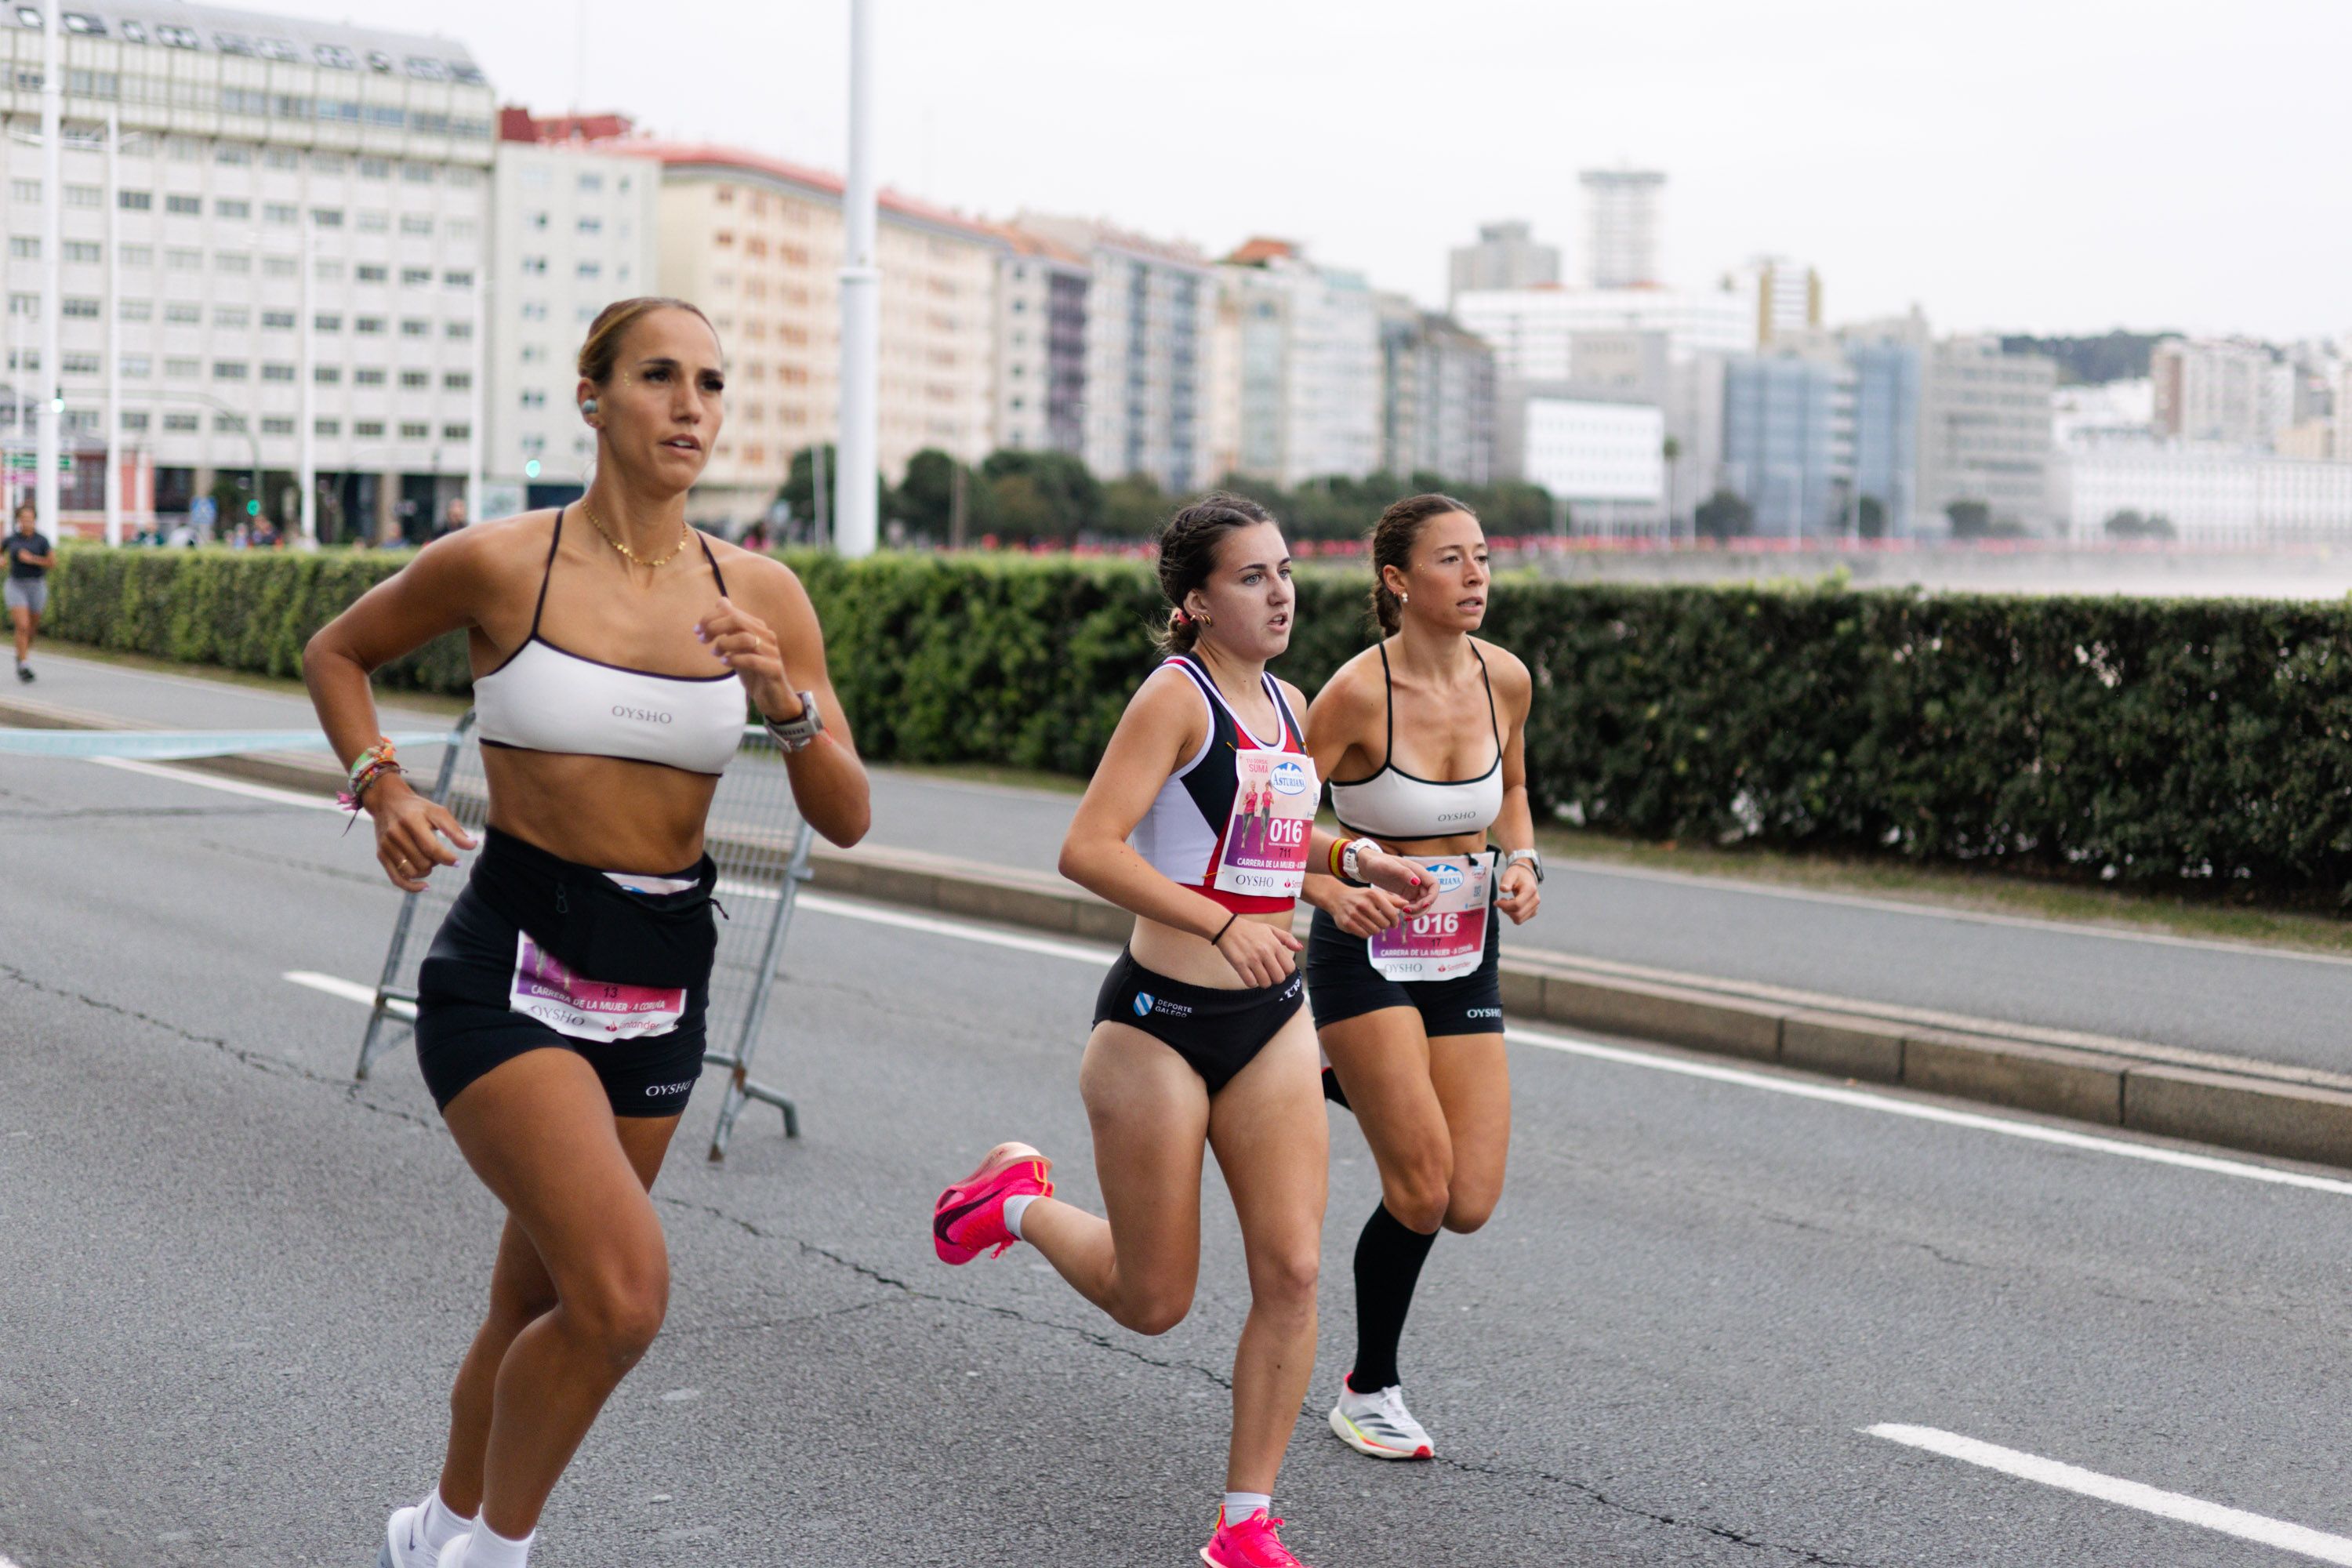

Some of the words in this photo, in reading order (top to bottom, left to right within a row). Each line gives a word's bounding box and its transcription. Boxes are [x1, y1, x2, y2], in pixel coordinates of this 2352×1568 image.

[612, 705, 672, 724] OYSHO
[1248, 764, 1269, 773] SUMA
[1438, 811, 1476, 822] OYSHO
[1270, 819, 1303, 844] 016
[1279, 848, 1291, 858] 711
[1237, 858, 1265, 869] CARRERA
[1236, 874, 1274, 887] OYSHO
[1413, 913, 1459, 934] 016
[1432, 938, 1441, 947] 17
[1385, 963, 1423, 973] OYSHO
[531, 984, 572, 1003] CARRERA
[573, 999, 584, 1008] DE
[586, 1000, 597, 1010] LA
[599, 1001, 628, 1012] MUJER
[603, 986, 619, 999] 13
[1157, 999, 1192, 1013] DEPORTE
[1467, 1008, 1502, 1018] OYSHO
[619, 1021, 660, 1029] antander
[645, 1080, 691, 1097] OYSHO
